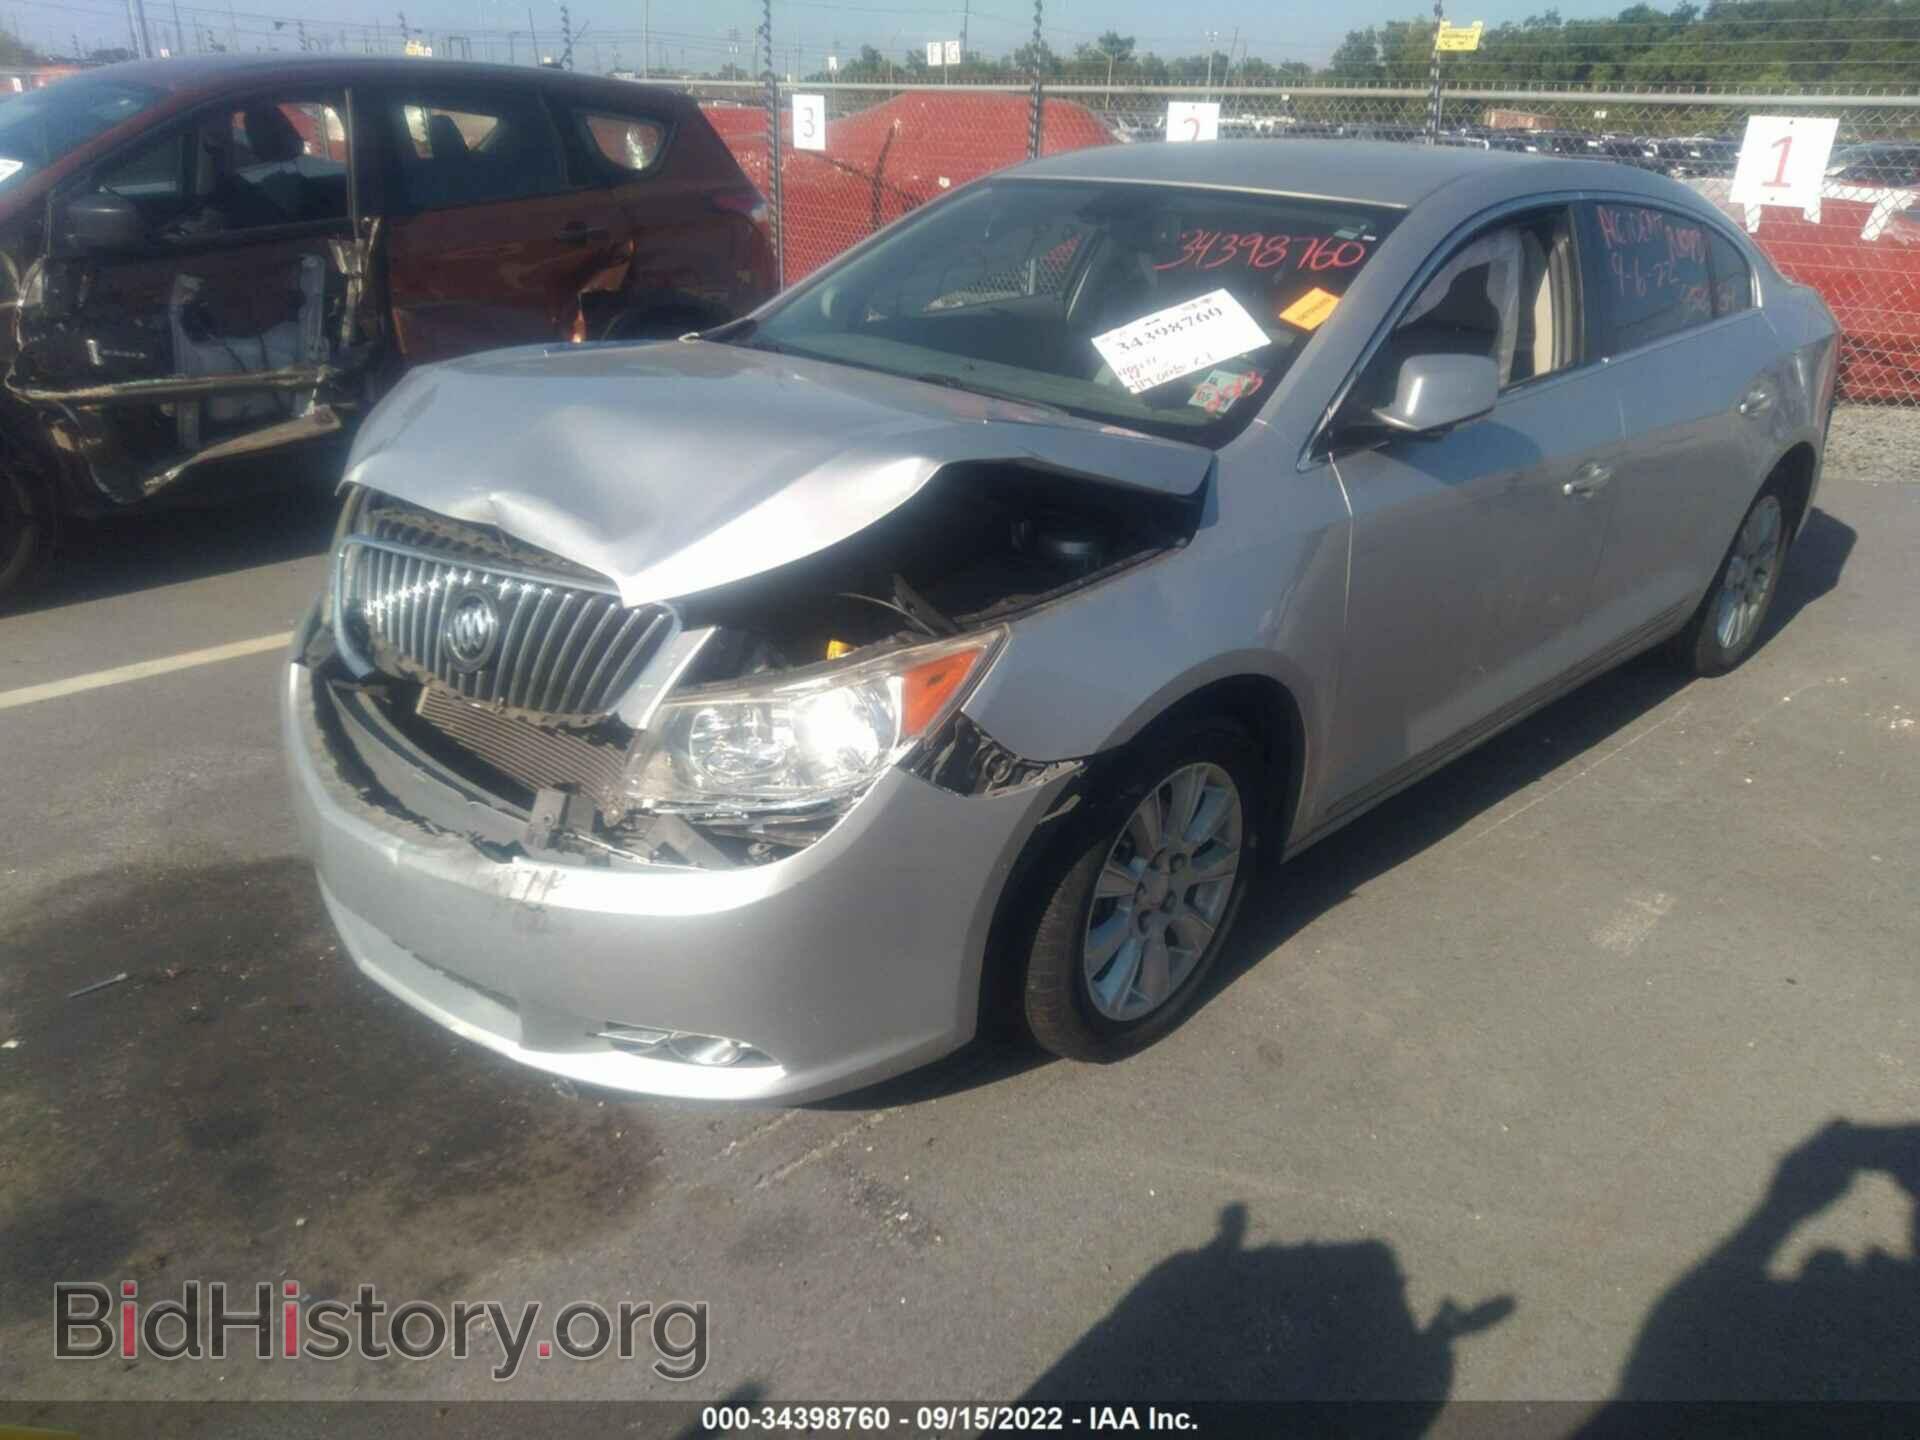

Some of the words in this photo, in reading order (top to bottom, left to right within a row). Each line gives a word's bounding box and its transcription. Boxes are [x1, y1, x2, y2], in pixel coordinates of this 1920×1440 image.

[802, 106, 816, 138] 3
[1761, 135, 1792, 188] 1
[1152, 229, 1366, 270] 34398760
